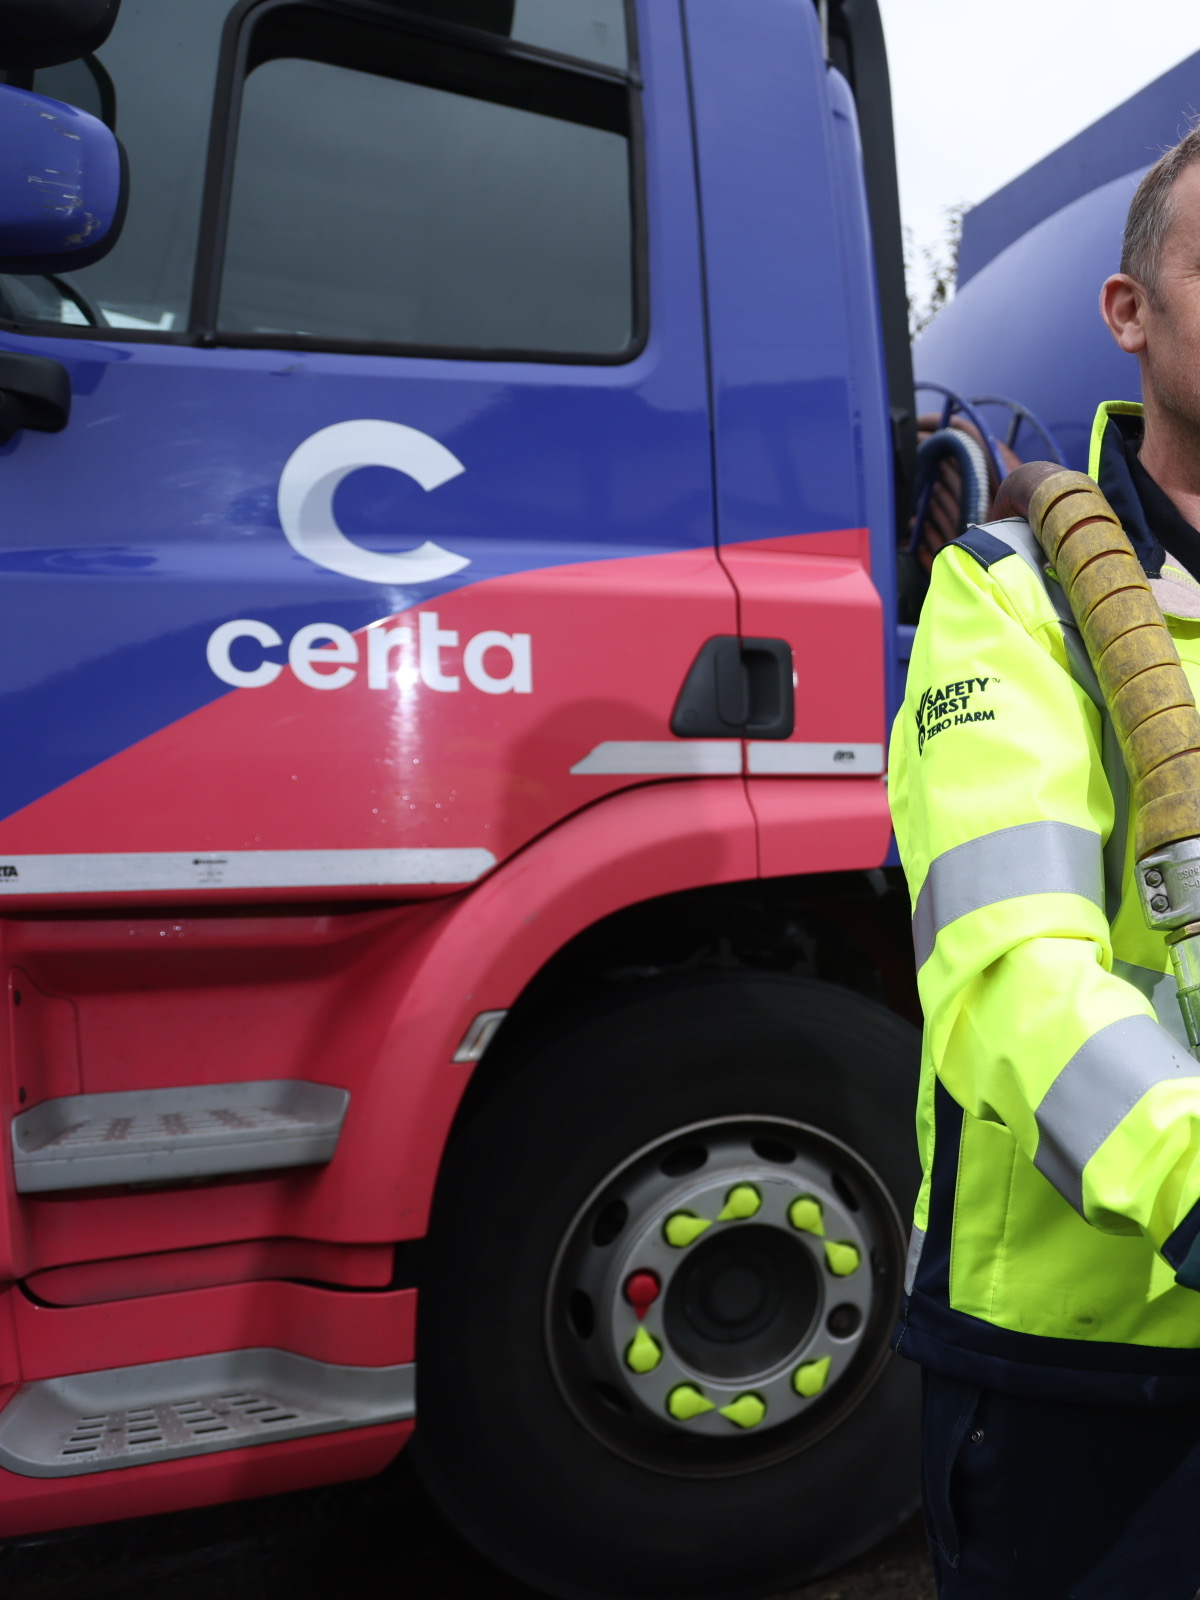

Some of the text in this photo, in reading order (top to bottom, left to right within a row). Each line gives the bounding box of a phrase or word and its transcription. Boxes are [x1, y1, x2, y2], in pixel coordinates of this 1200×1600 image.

[206, 611, 533, 694] certa
[926, 677, 989, 710] SAFETY
[926, 709, 995, 741] ZERO HARM
[927, 695, 970, 726] FIRST
